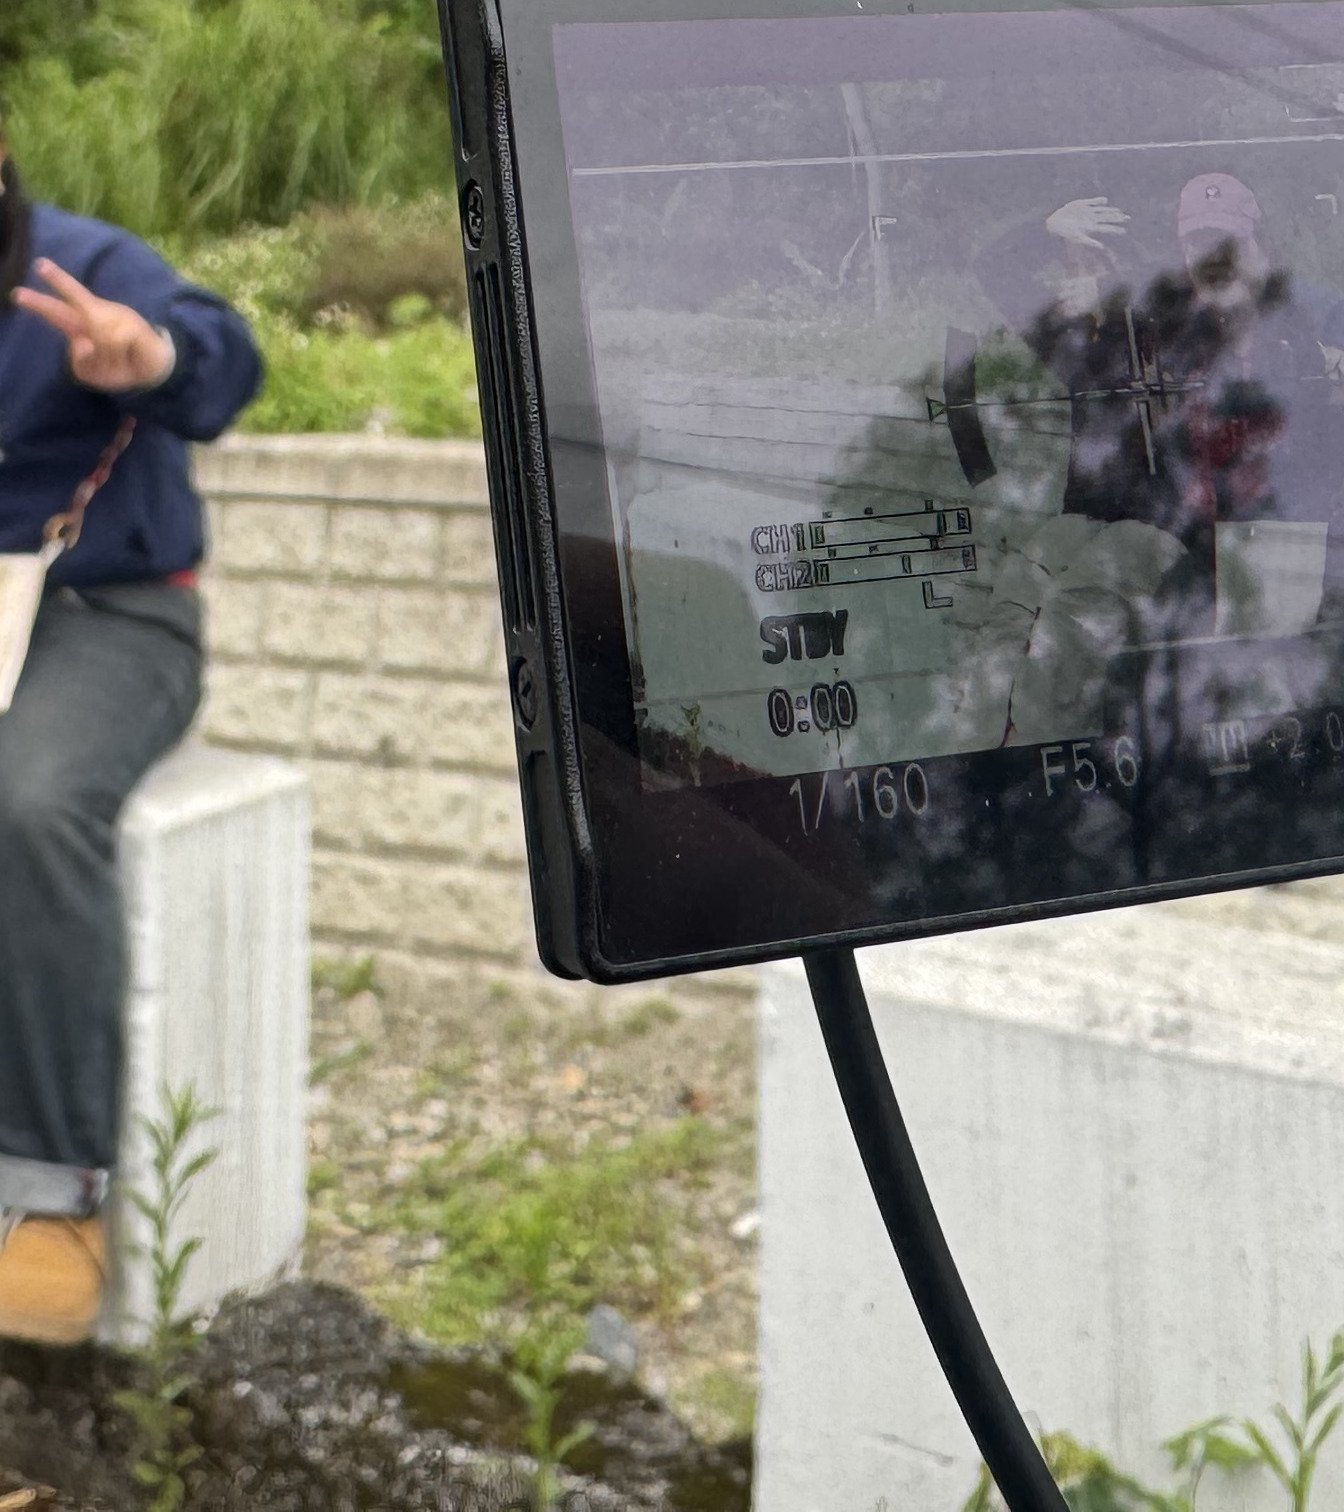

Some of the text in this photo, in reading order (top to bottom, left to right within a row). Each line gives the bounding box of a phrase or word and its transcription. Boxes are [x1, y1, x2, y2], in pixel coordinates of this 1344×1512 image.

[751, 523, 806, 555] CH1
[756, 560, 813, 592] CH2
[767, 679, 857, 738] 0:00
[1040, 735, 1138, 797] F5.6
